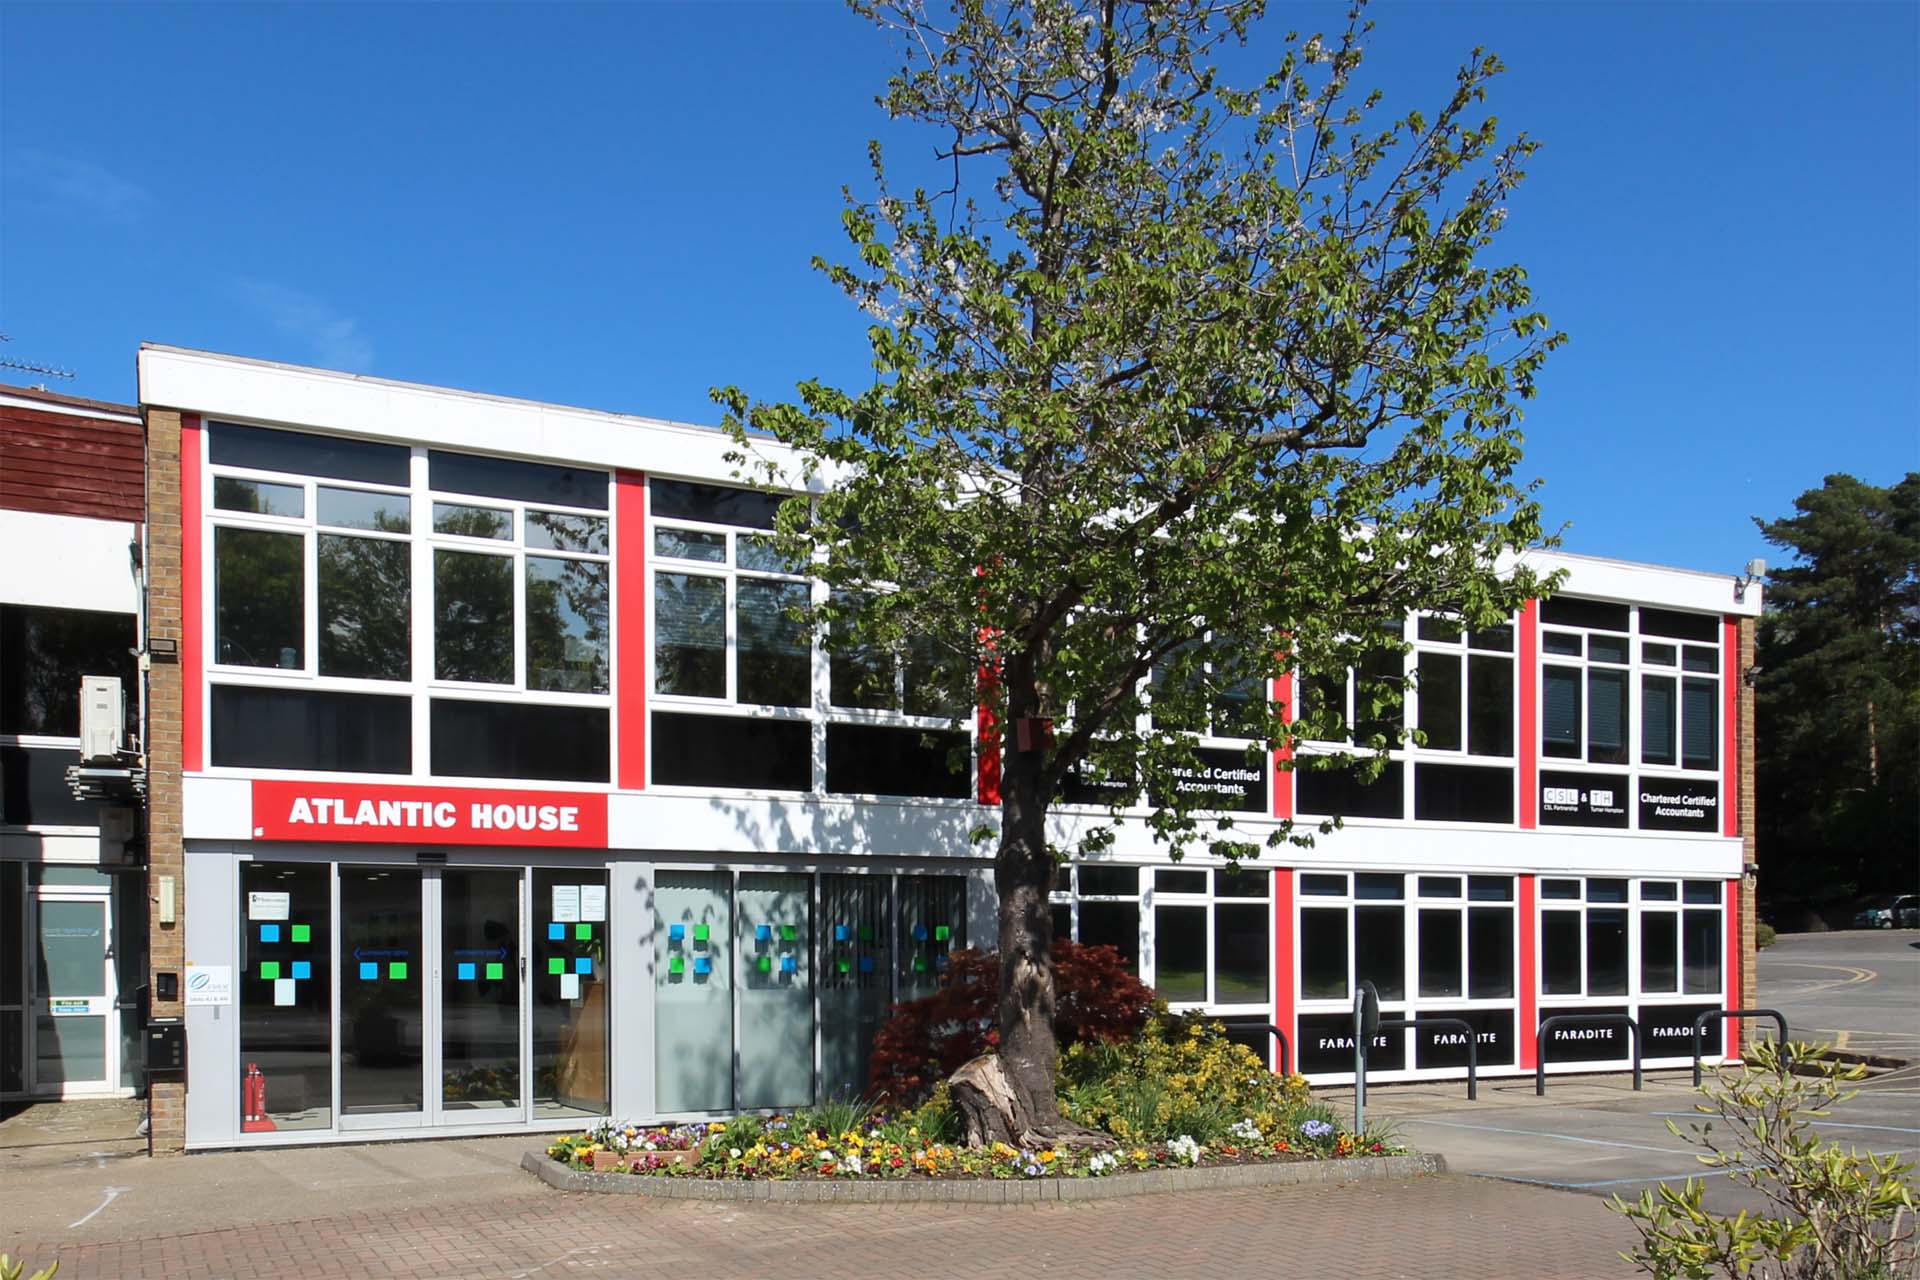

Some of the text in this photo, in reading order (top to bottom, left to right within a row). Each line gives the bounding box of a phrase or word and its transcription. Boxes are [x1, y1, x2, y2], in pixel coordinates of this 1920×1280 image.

[1213, 767, 1260, 782] Certified
[1580, 792, 1588, 803] &
[1593, 792, 1611, 804] TH
[1640, 793, 1716, 807] Chartered Certified
[288, 797, 579, 831] ATLANTIC HOUSE
[1655, 806, 1705, 818] Accountants
[1554, 1028, 1614, 1040] FARADITE
[1652, 1026, 1708, 1038] FARADIE
[1319, 1036, 1387, 1049] FARATE
[1433, 1032, 1497, 1046] FARAITE
